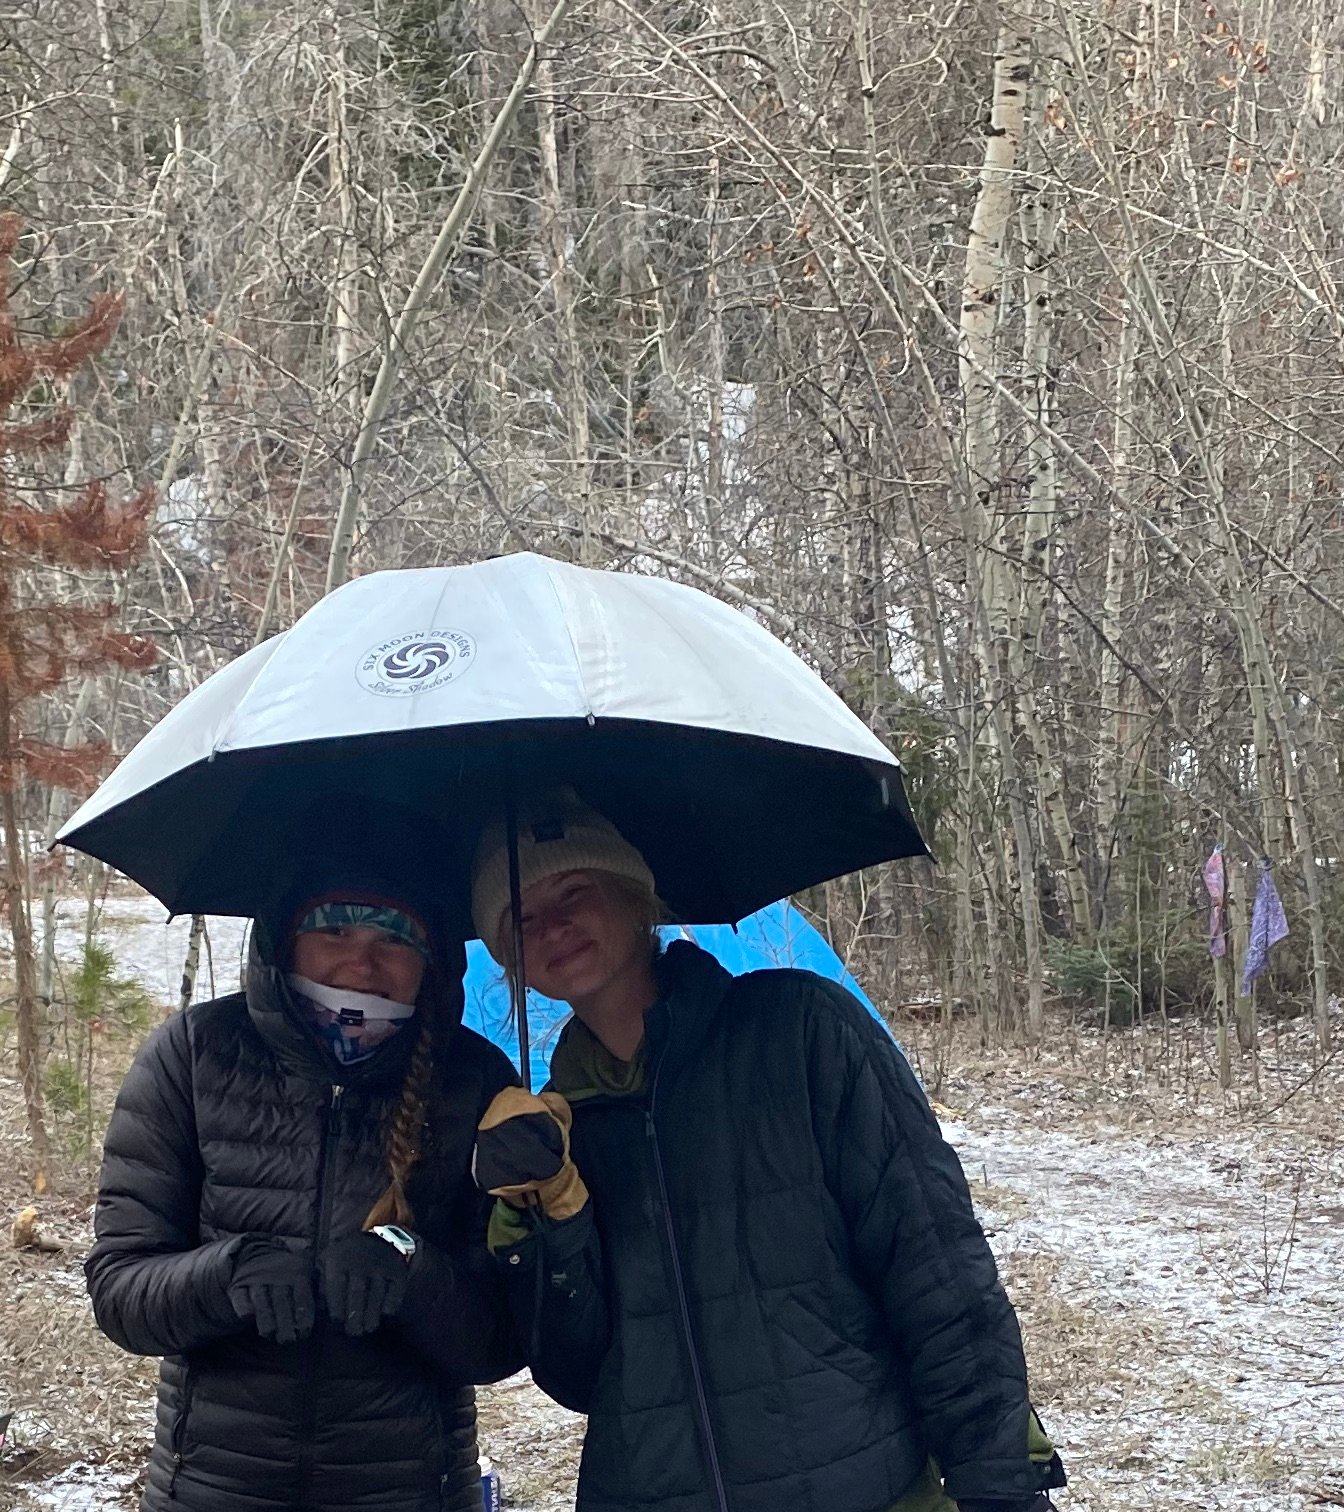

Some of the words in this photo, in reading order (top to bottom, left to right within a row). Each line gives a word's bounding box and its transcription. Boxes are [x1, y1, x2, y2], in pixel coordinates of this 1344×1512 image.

[363, 653, 379, 670] SIX
[378, 632, 425, 653] MOON
[431, 630, 471, 658] DESIGNS
[405, 672, 453, 693] Shadow
